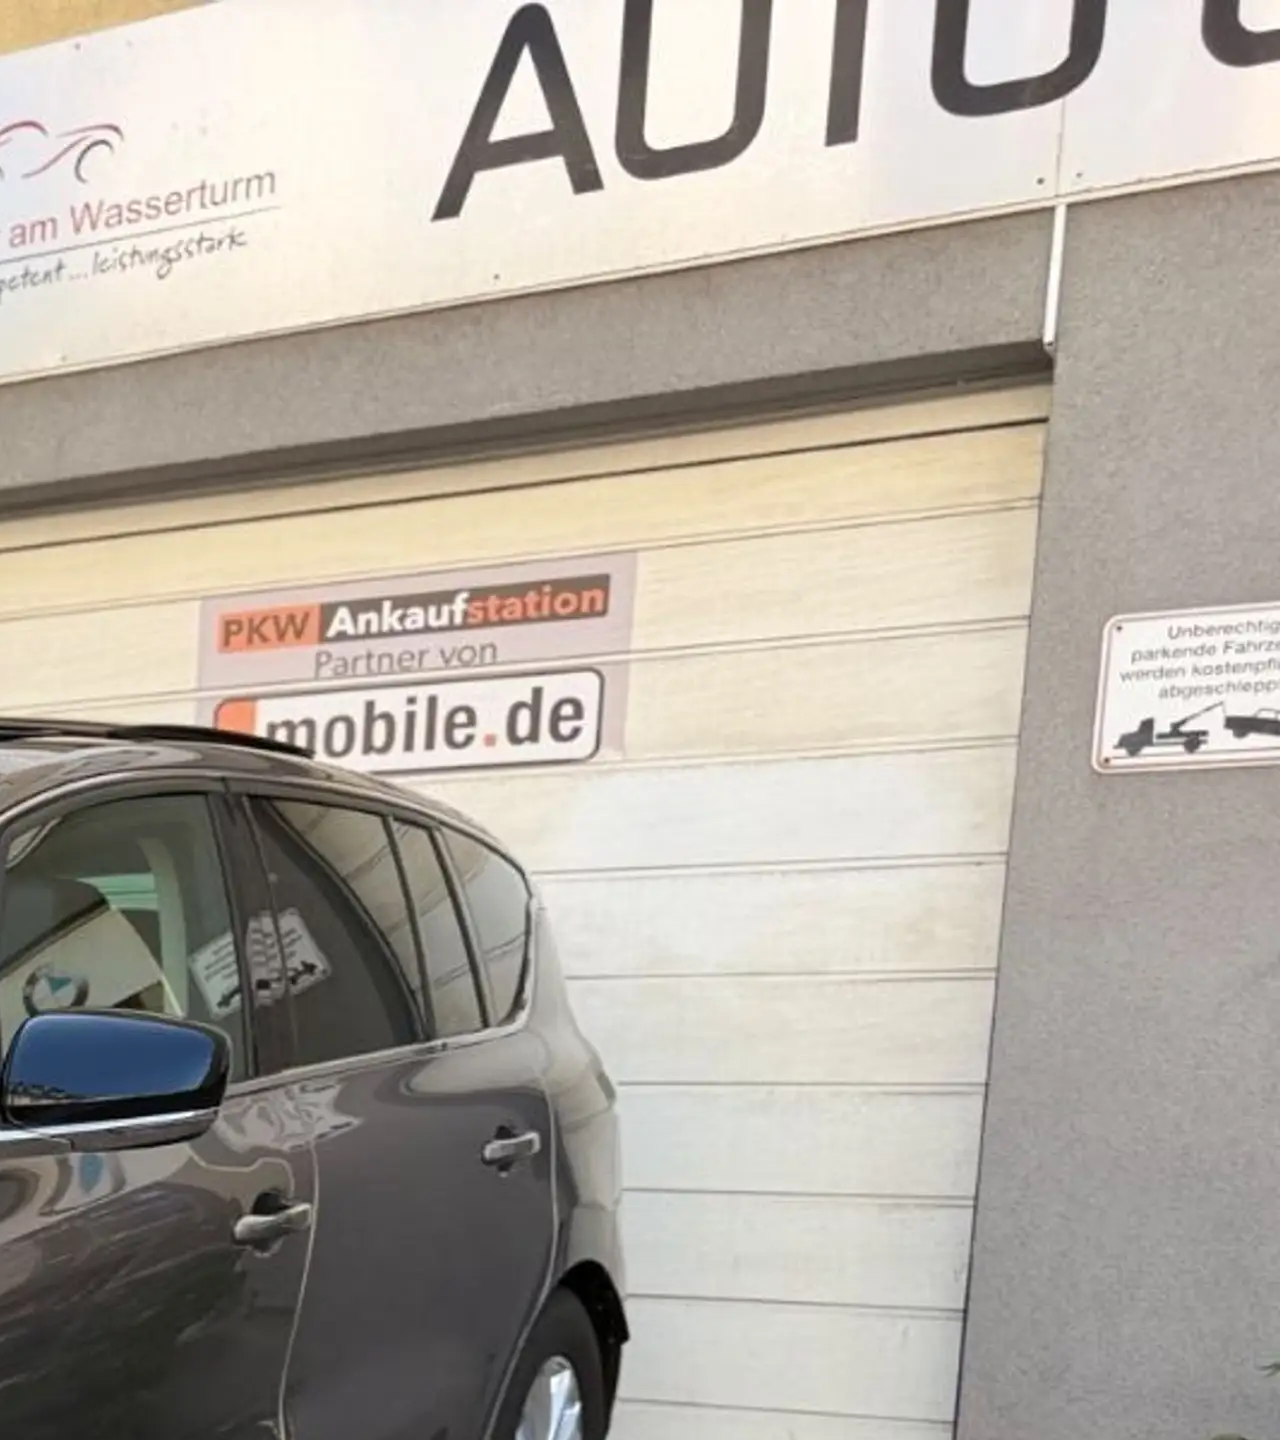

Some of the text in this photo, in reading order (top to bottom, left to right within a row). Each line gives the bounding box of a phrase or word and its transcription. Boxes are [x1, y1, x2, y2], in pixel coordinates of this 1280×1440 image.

[8, 214, 58, 249] am
[69, 169, 277, 236] Wasserturm
[222, 584, 607, 650] PKW Ankaufstation
[313, 640, 498, 680] Partner von
[1130, 643, 1216, 666] parkende
[265, 685, 586, 761] mobile.de
